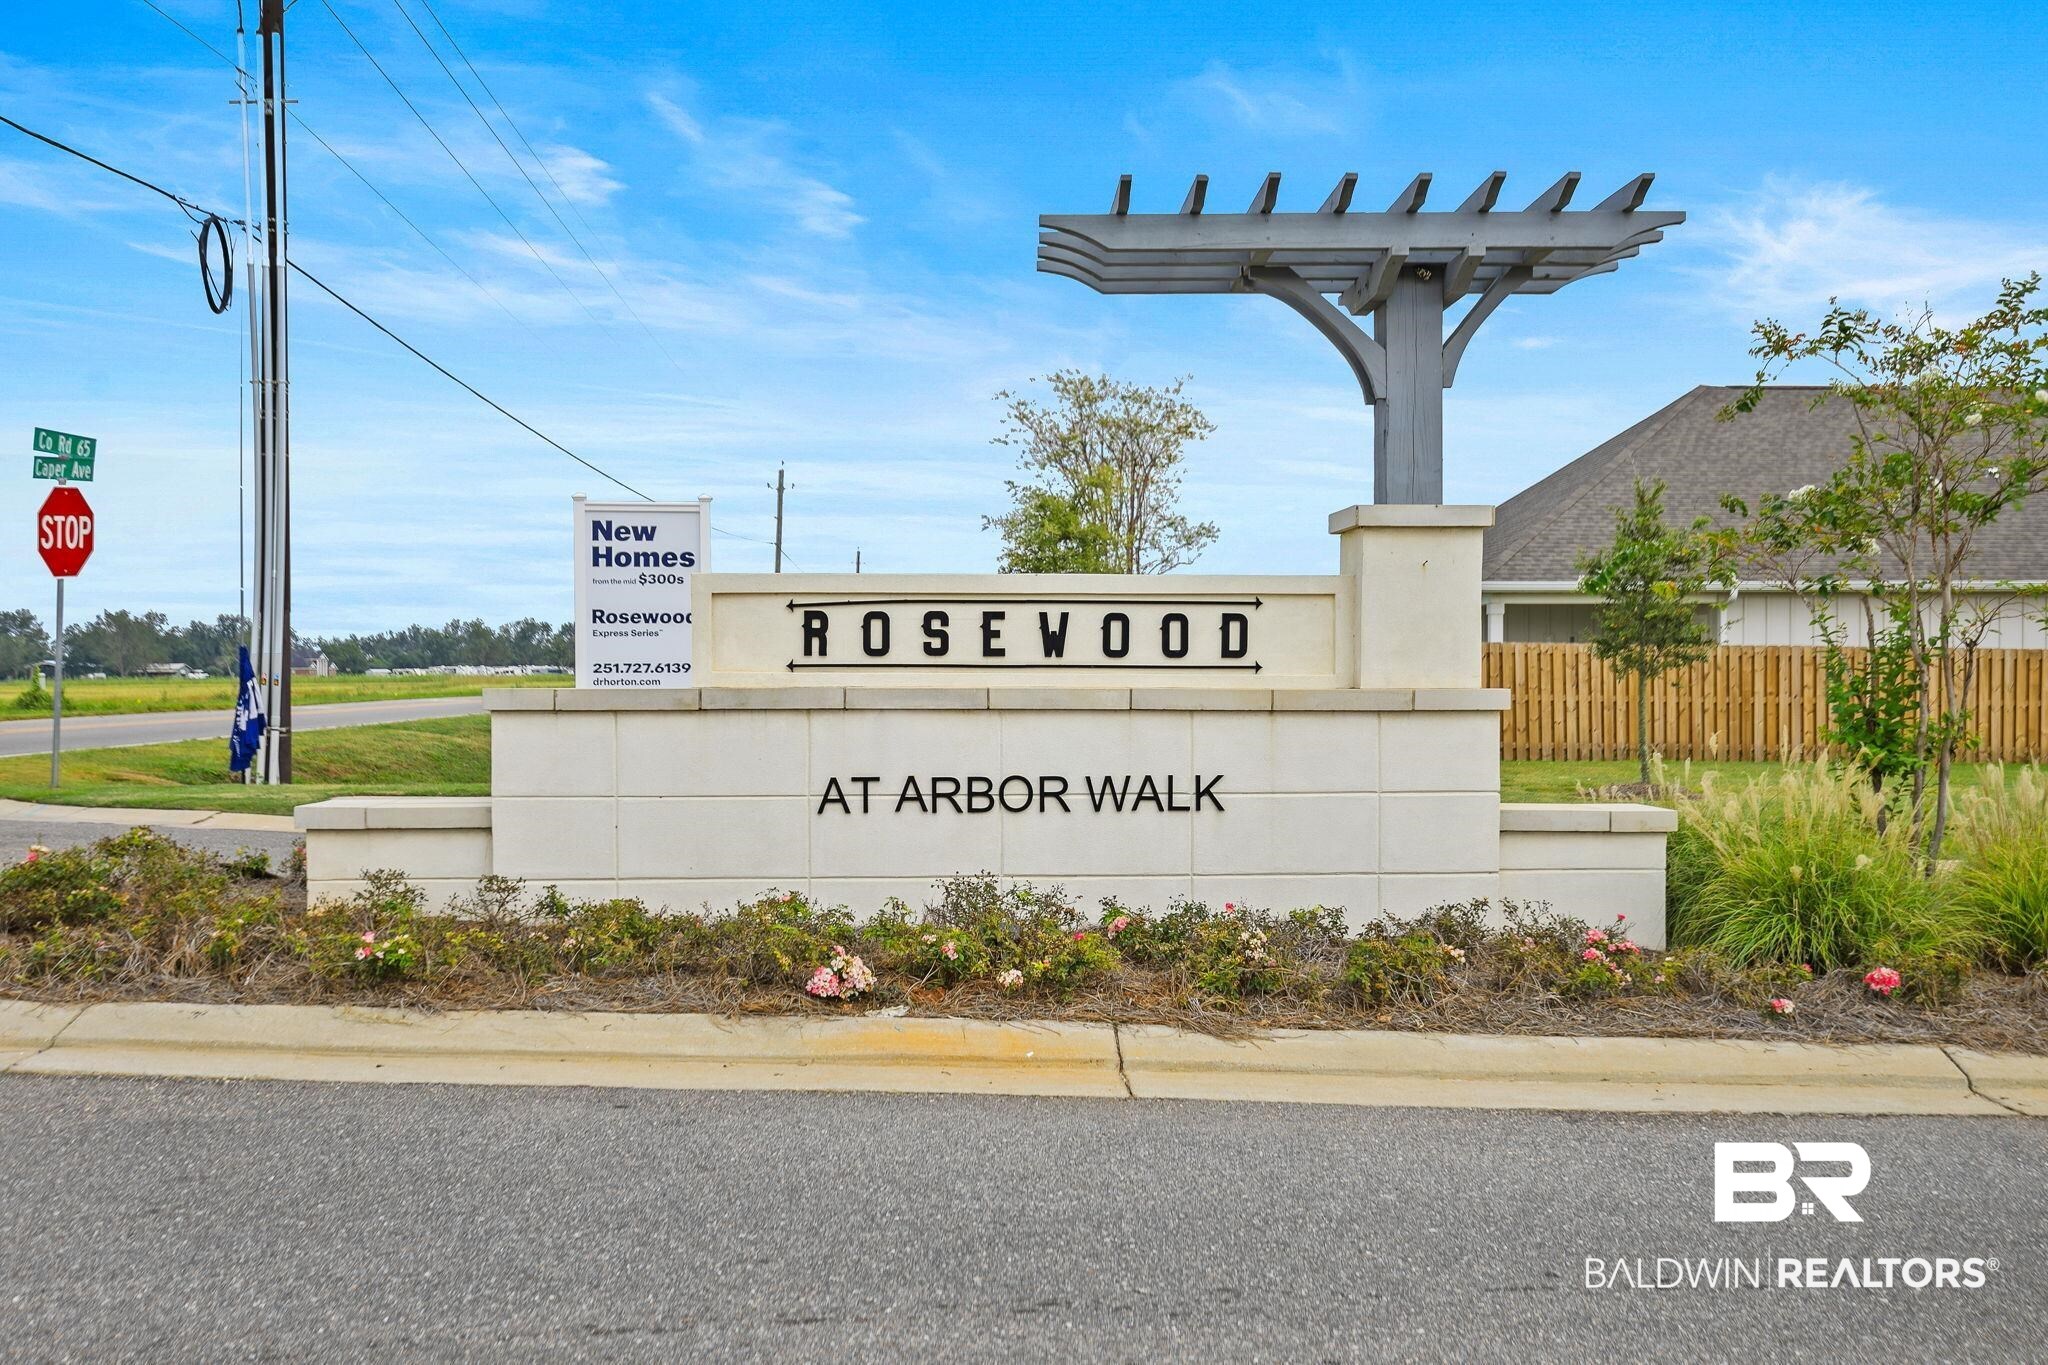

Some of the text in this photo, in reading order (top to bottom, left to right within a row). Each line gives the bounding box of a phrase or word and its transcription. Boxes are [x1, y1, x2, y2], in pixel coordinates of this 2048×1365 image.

[39, 431, 91, 457] Co Rd 65
[35, 458, 92, 480] Caper Ave
[40, 514, 92, 550] STOP
[592, 519, 657, 542] New
[592, 546, 696, 568] Homes
[592, 572, 684, 586] from the mid $300s
[592, 629, 629, 638] Express
[801, 609, 1248, 659] ROSEWOOD
[593, 662, 691, 674] 251.727.6139
[593, 677, 661, 686] drhorton.com
[817, 774, 1226, 815] AT ARBOR WALK
